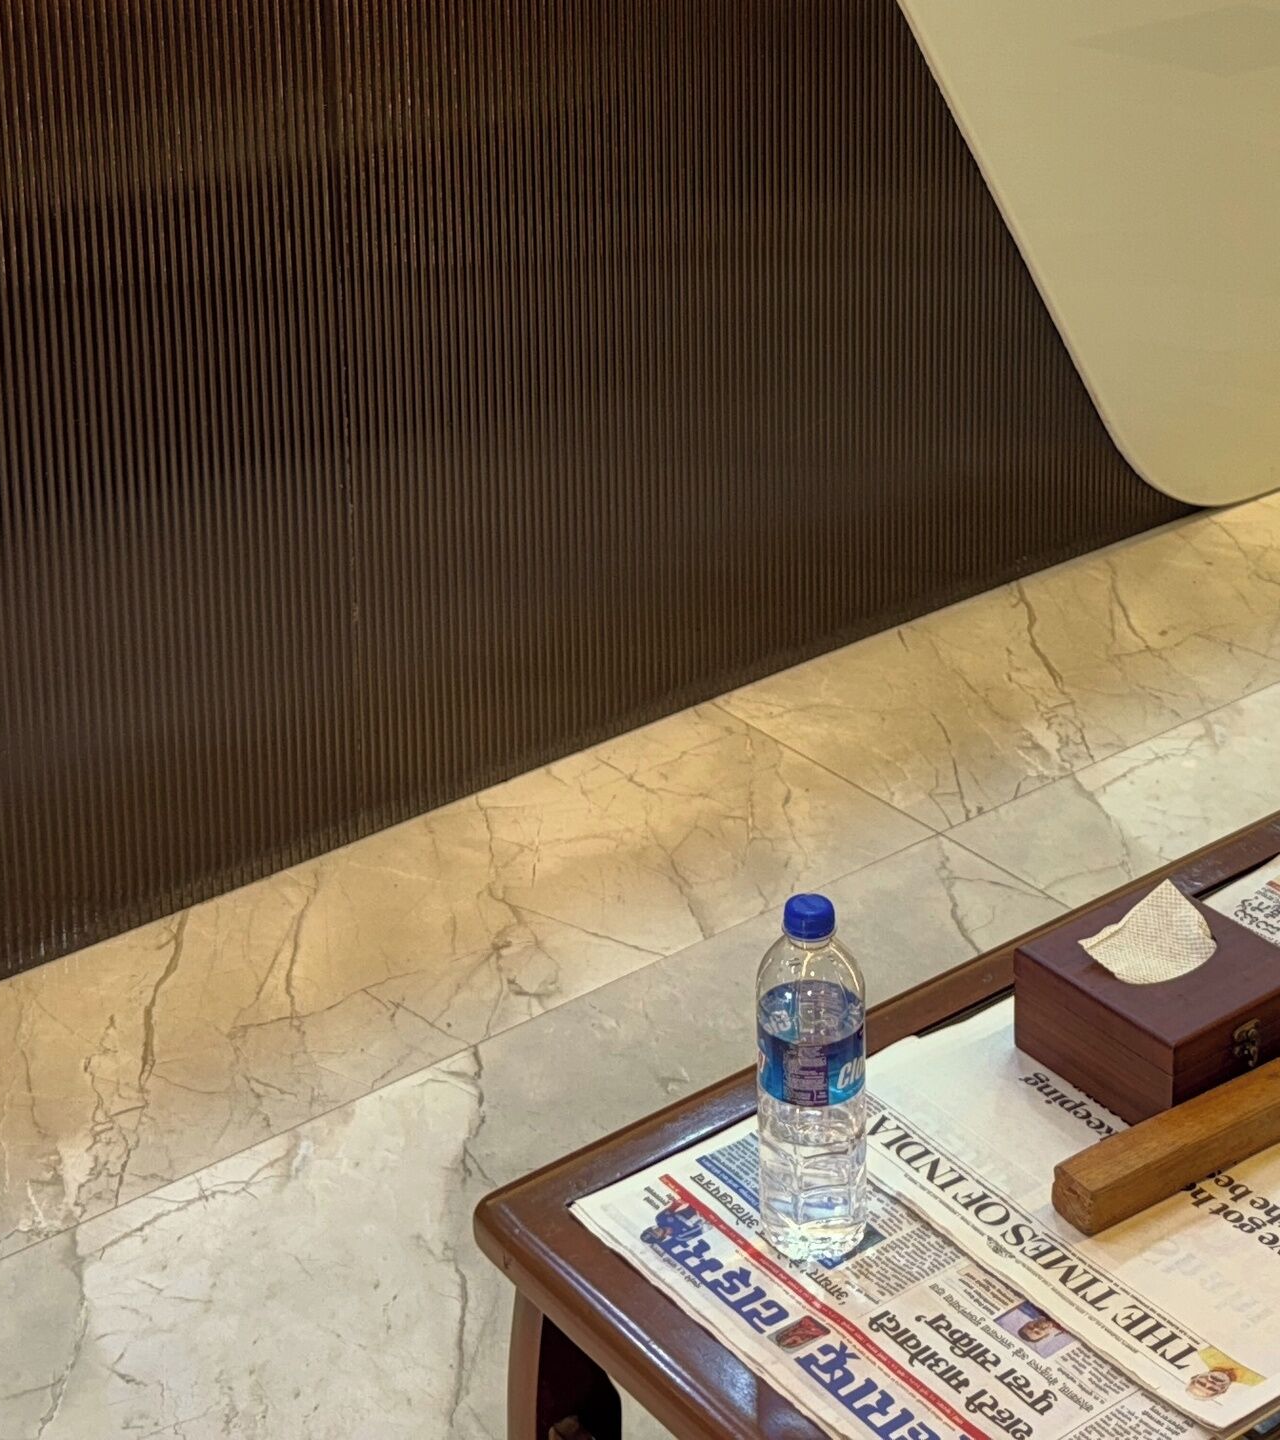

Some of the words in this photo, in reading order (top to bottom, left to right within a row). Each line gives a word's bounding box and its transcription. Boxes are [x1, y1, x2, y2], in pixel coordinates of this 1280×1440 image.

[869, 1116, 965, 1191] INDIA
[690, 1174, 759, 1228] ओळखपत्रच
[953, 1192, 1010, 1226] OF
[1209, 1203, 1265, 1233] got
[1002, 1224, 1117, 1310] TIMES
[869, 1311, 969, 1392] माओवादी
[1113, 1305, 1196, 1368] THE
[965, 1389, 1032, 1440] शहरी
[995, 1369, 1056, 1414] पुन्हा
